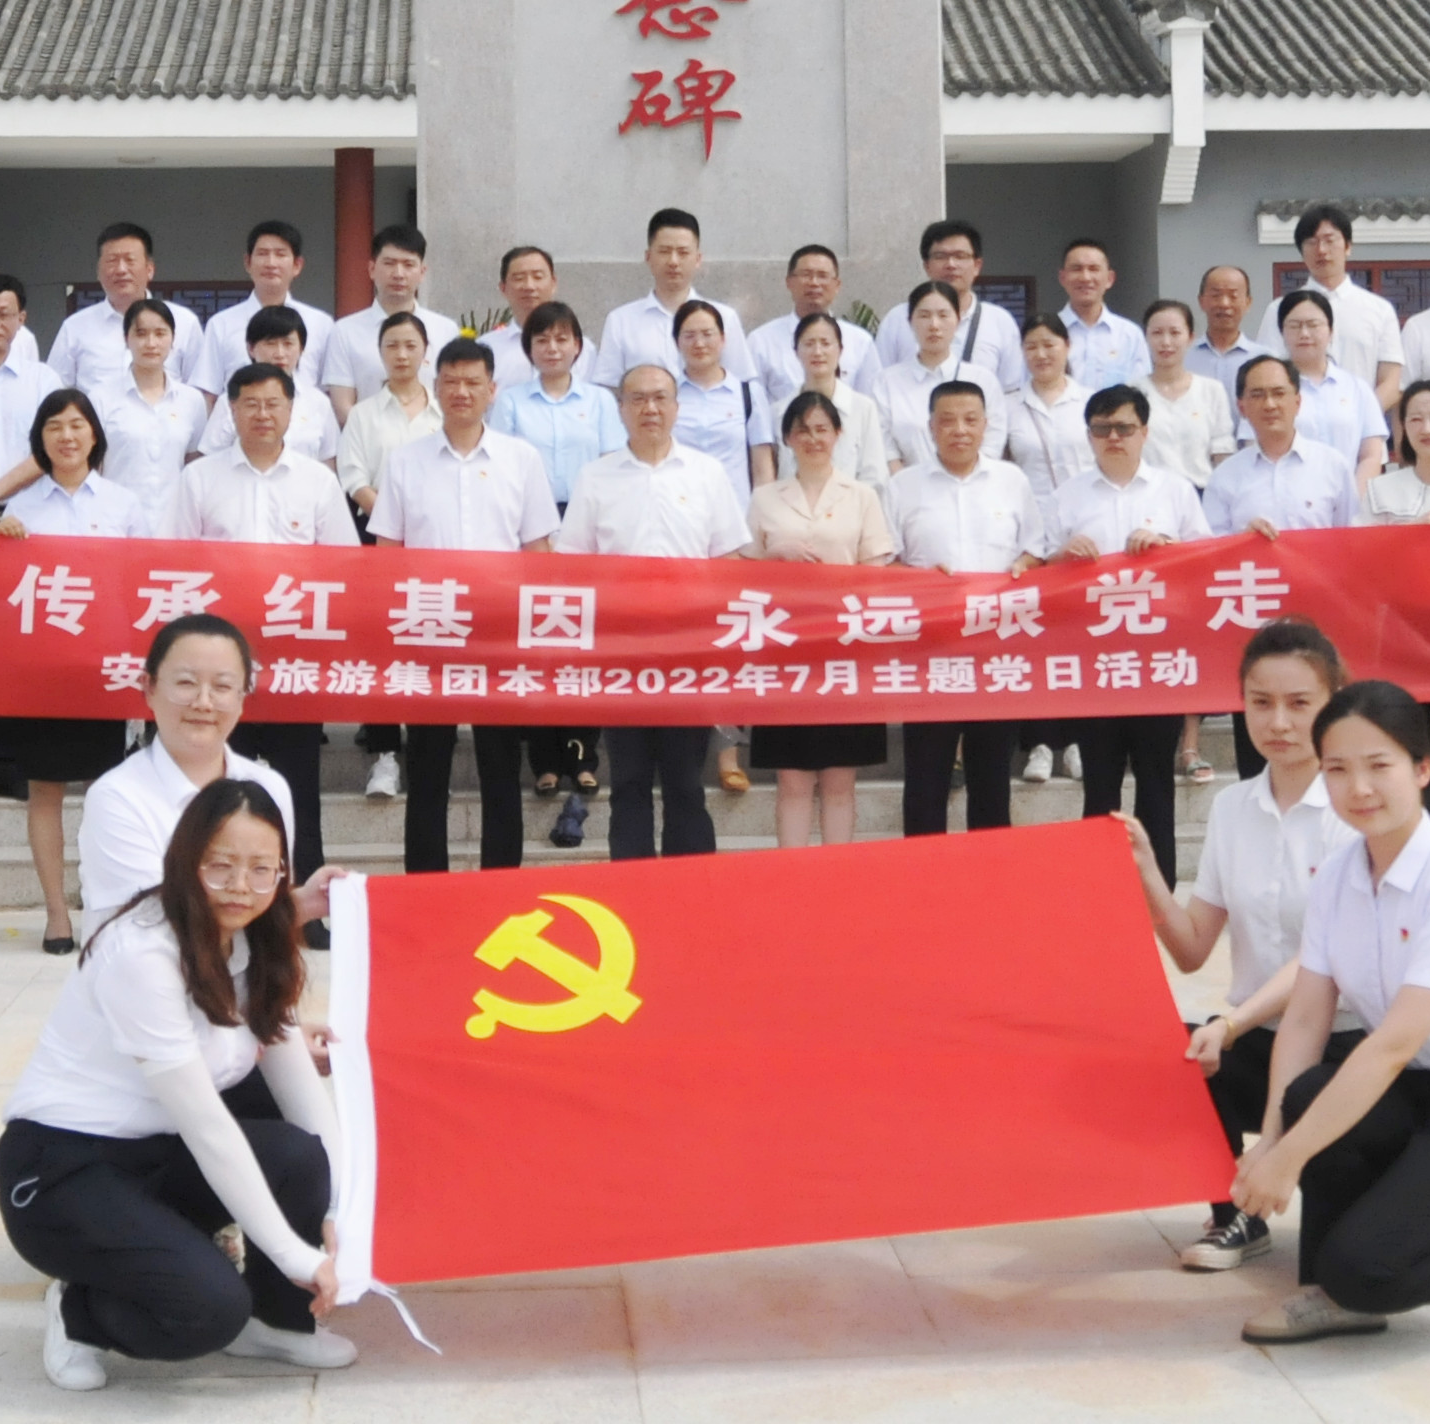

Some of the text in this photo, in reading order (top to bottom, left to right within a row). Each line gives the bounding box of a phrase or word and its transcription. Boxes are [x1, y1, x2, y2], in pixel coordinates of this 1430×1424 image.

[8, 561, 1290, 652] 传承红基因 永远跟党走
[101, 647, 1199, 698] 安旅游集团本部2022年7月主题党日活动
